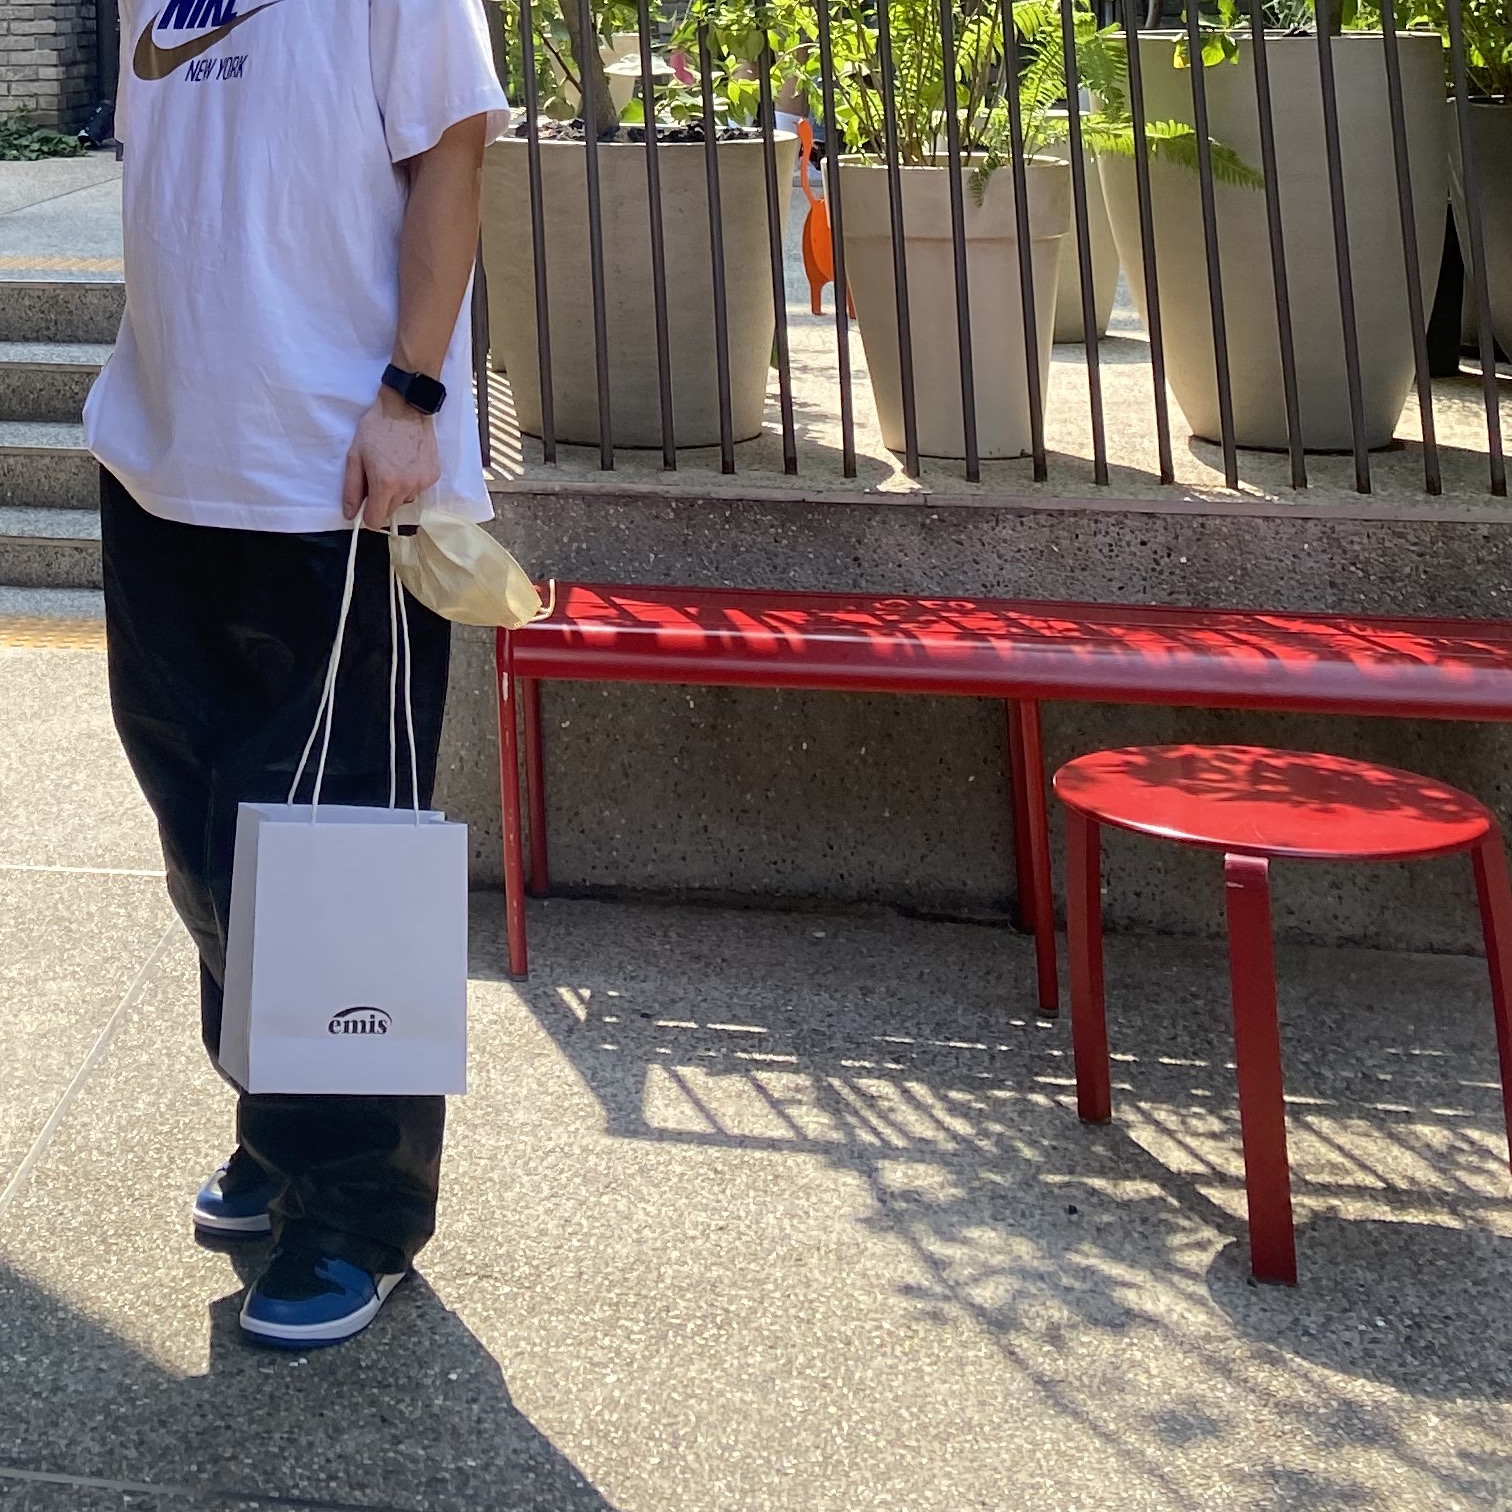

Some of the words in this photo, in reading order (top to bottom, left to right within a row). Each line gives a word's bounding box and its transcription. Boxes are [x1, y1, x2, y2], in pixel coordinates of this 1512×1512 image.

[185, 57, 217, 81] NEW
[216, 55, 248, 80] YORK
[328, 1013, 389, 1035] emis
